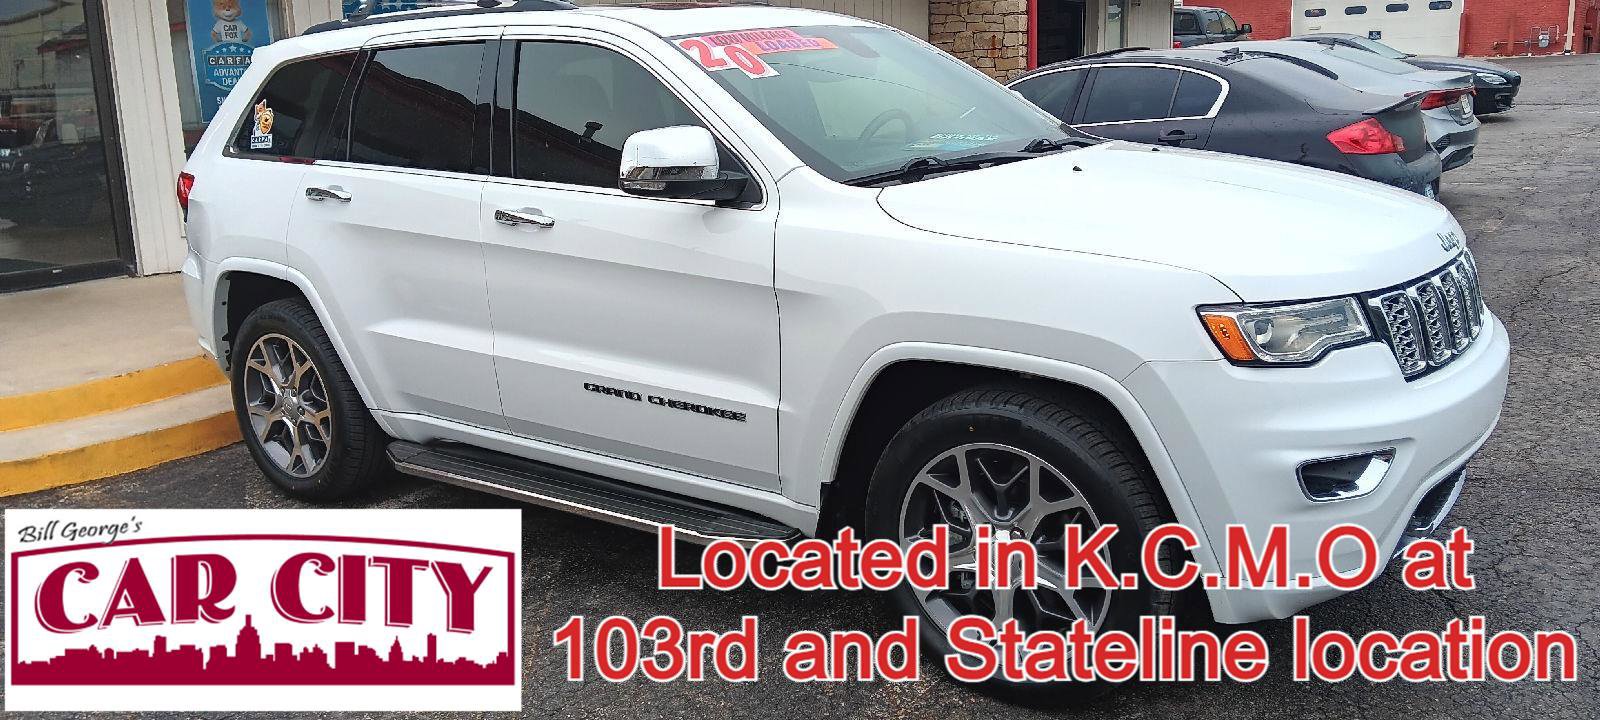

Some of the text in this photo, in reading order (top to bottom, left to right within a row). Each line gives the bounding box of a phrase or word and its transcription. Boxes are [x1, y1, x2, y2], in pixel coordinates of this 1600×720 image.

[223, 24, 238, 32] CAR
[224, 31, 239, 39] FOX
[708, 29, 795, 47] LOW MILEAGE
[755, 38, 822, 52] LOADED
[209, 56, 251, 65] CARFA
[213, 68, 245, 77] ADVANT
[222, 77, 239, 86] DEA
[583, 382, 747, 423] GRAND CHEROKEE
